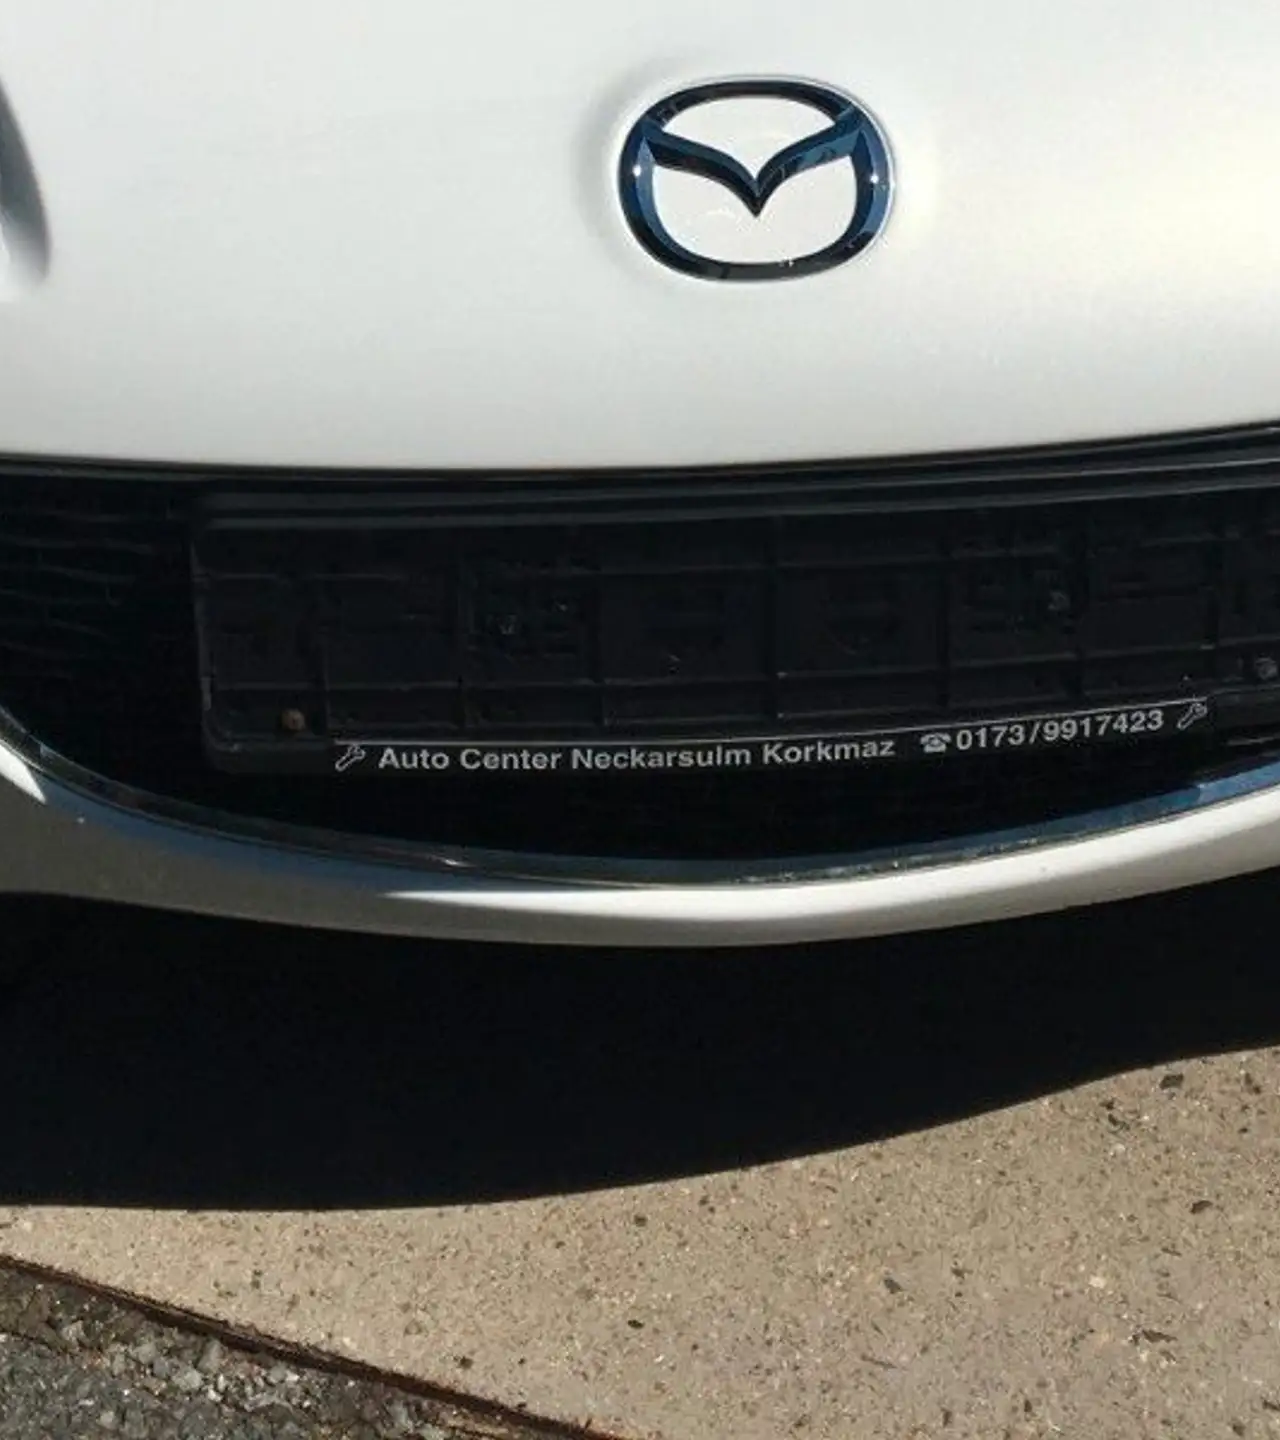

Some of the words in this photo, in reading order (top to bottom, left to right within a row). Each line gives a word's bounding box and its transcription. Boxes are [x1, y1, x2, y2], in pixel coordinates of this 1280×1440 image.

[378, 746, 451, 770] Auto
[460, 746, 562, 770] Center
[571, 744, 752, 769] Neckarsulm
[762, 735, 896, 765] Korkmaz
[956, 709, 1165, 752] 0173/9917423
